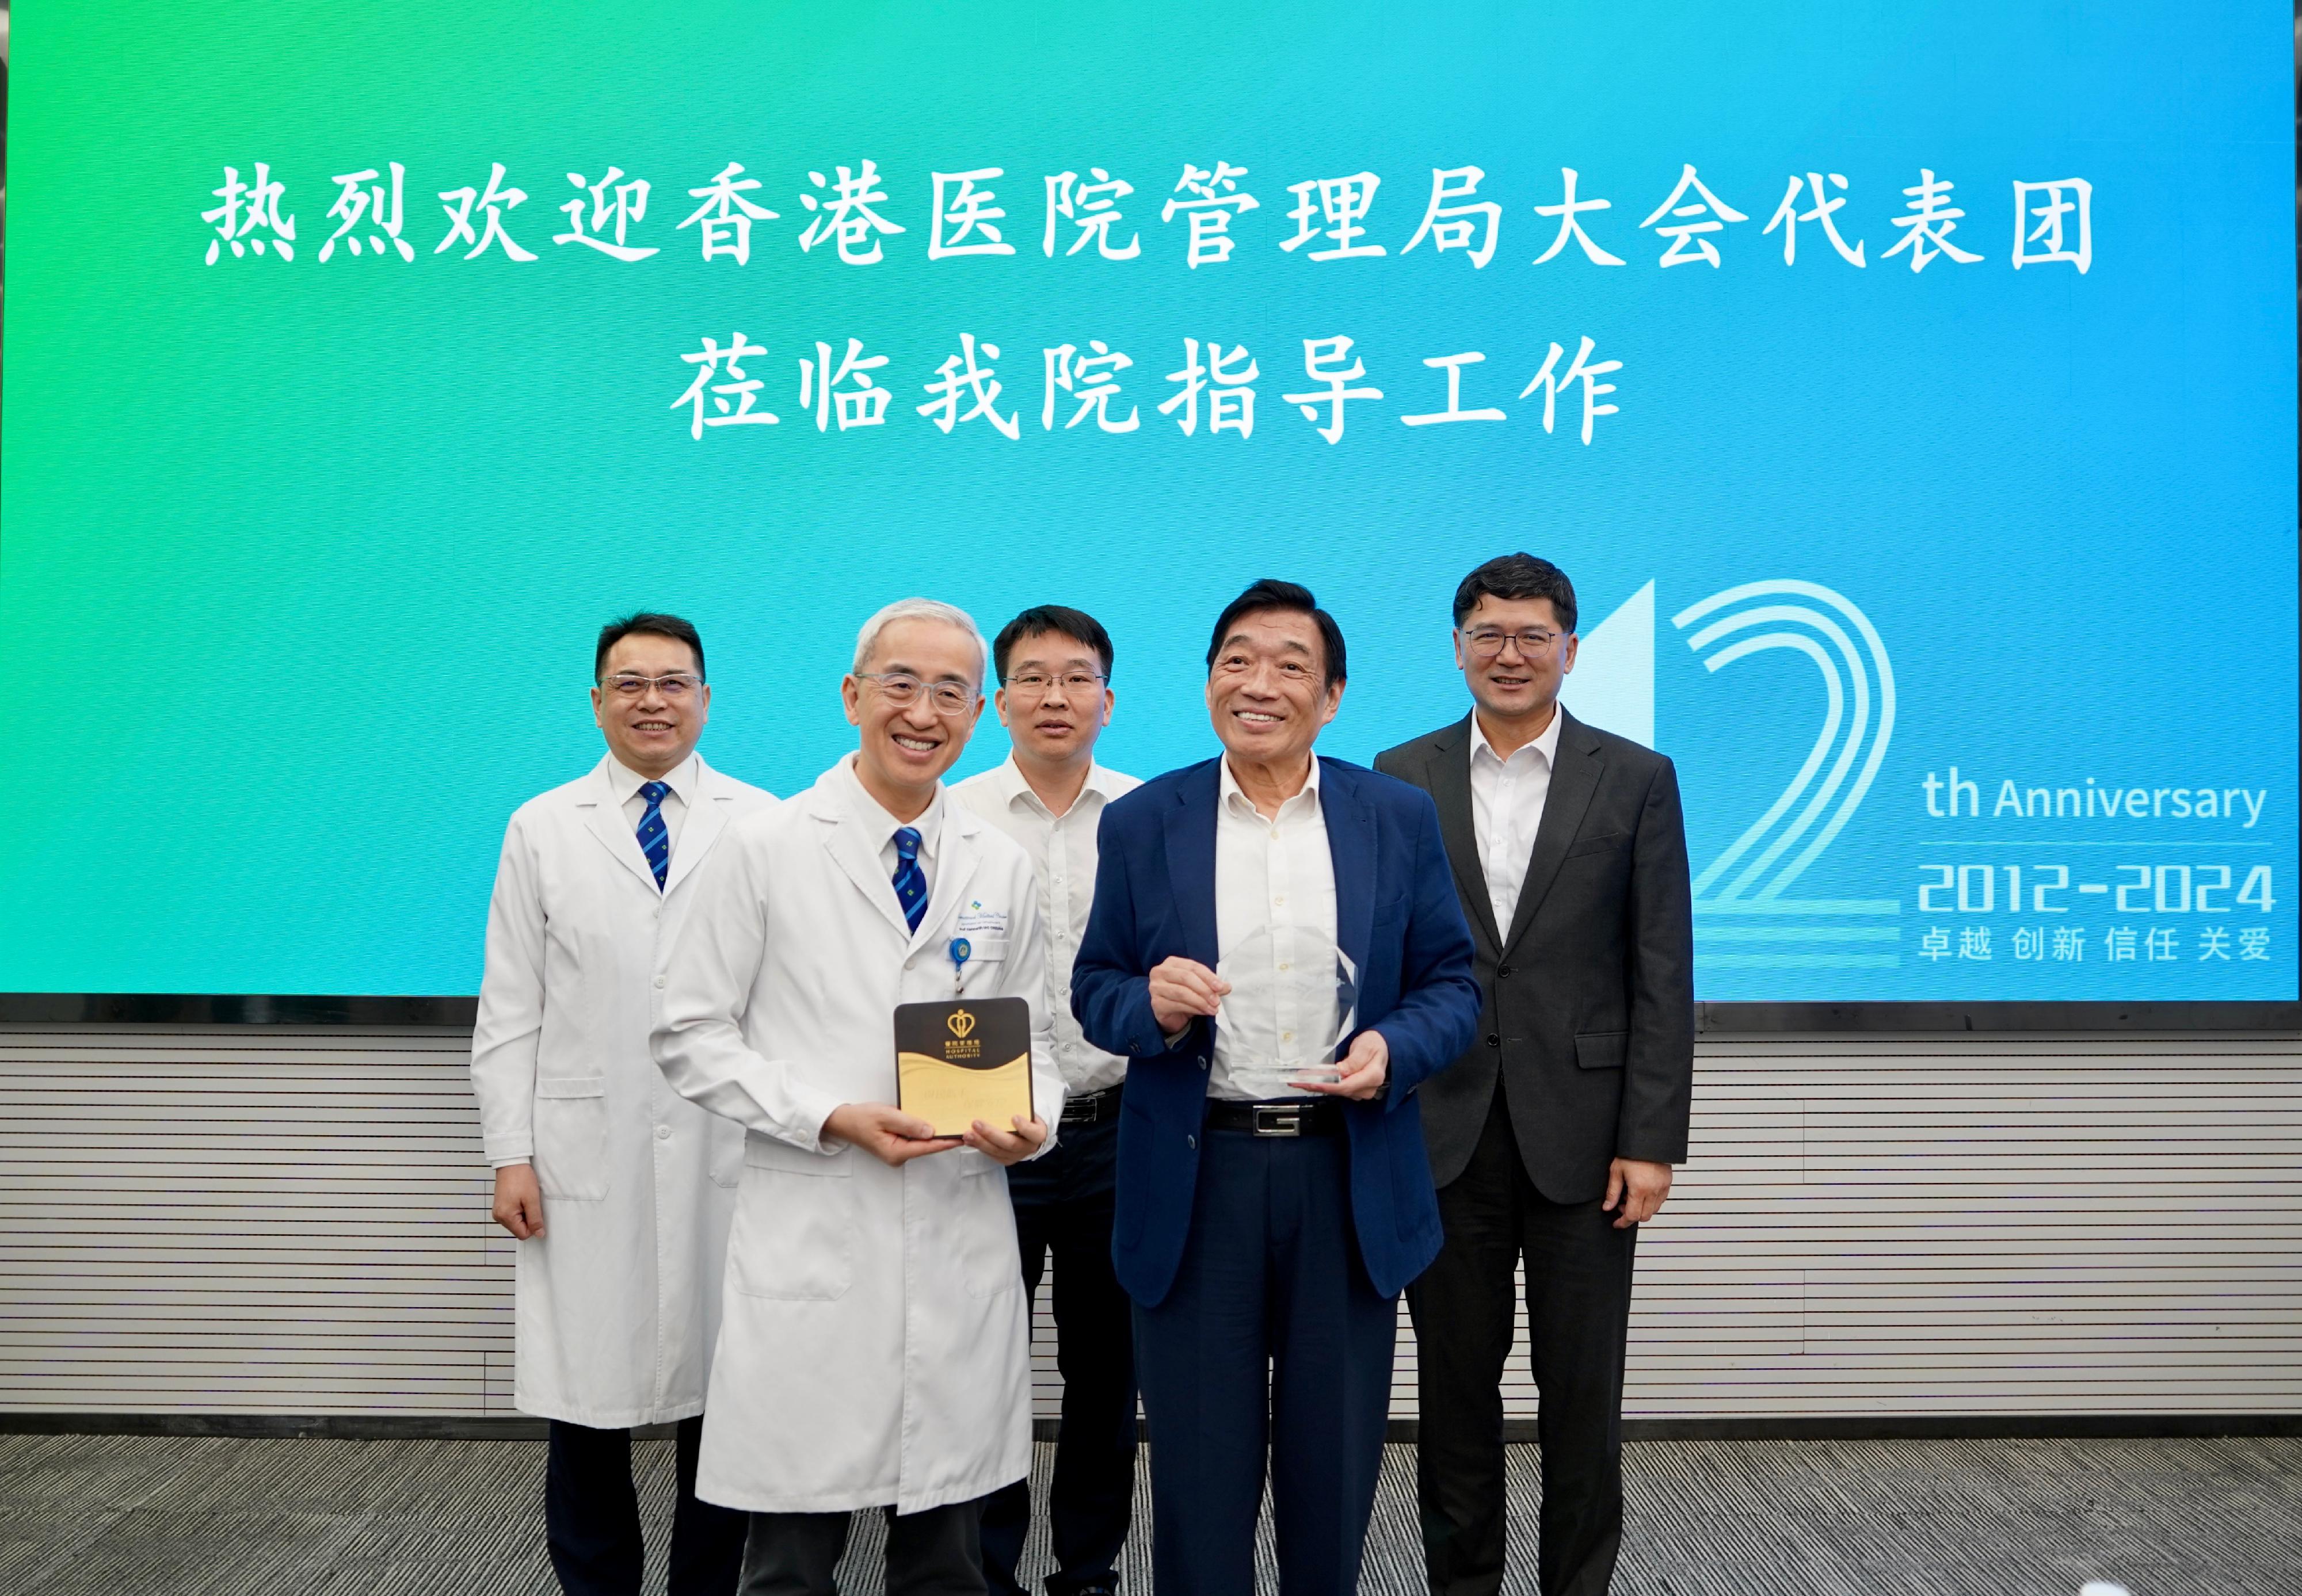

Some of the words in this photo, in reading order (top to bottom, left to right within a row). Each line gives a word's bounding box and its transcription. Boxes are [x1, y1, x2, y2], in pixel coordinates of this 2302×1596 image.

[200, 159, 2093, 275] 热烈欢迎香港医院管理局大会代表团
[669, 331, 1623, 446] 莅临我院指导工作
[1922, 766, 1979, 817] th
[1994, 777, 2267, 828] Anniversary
[1918, 864, 2276, 912] 2012-2024
[1919, 926, 1992, 961] 卓越
[2011, 926, 2086, 961] 创新
[2104, 926, 2179, 961] 信任
[2198, 926, 2271, 961] 关爱
